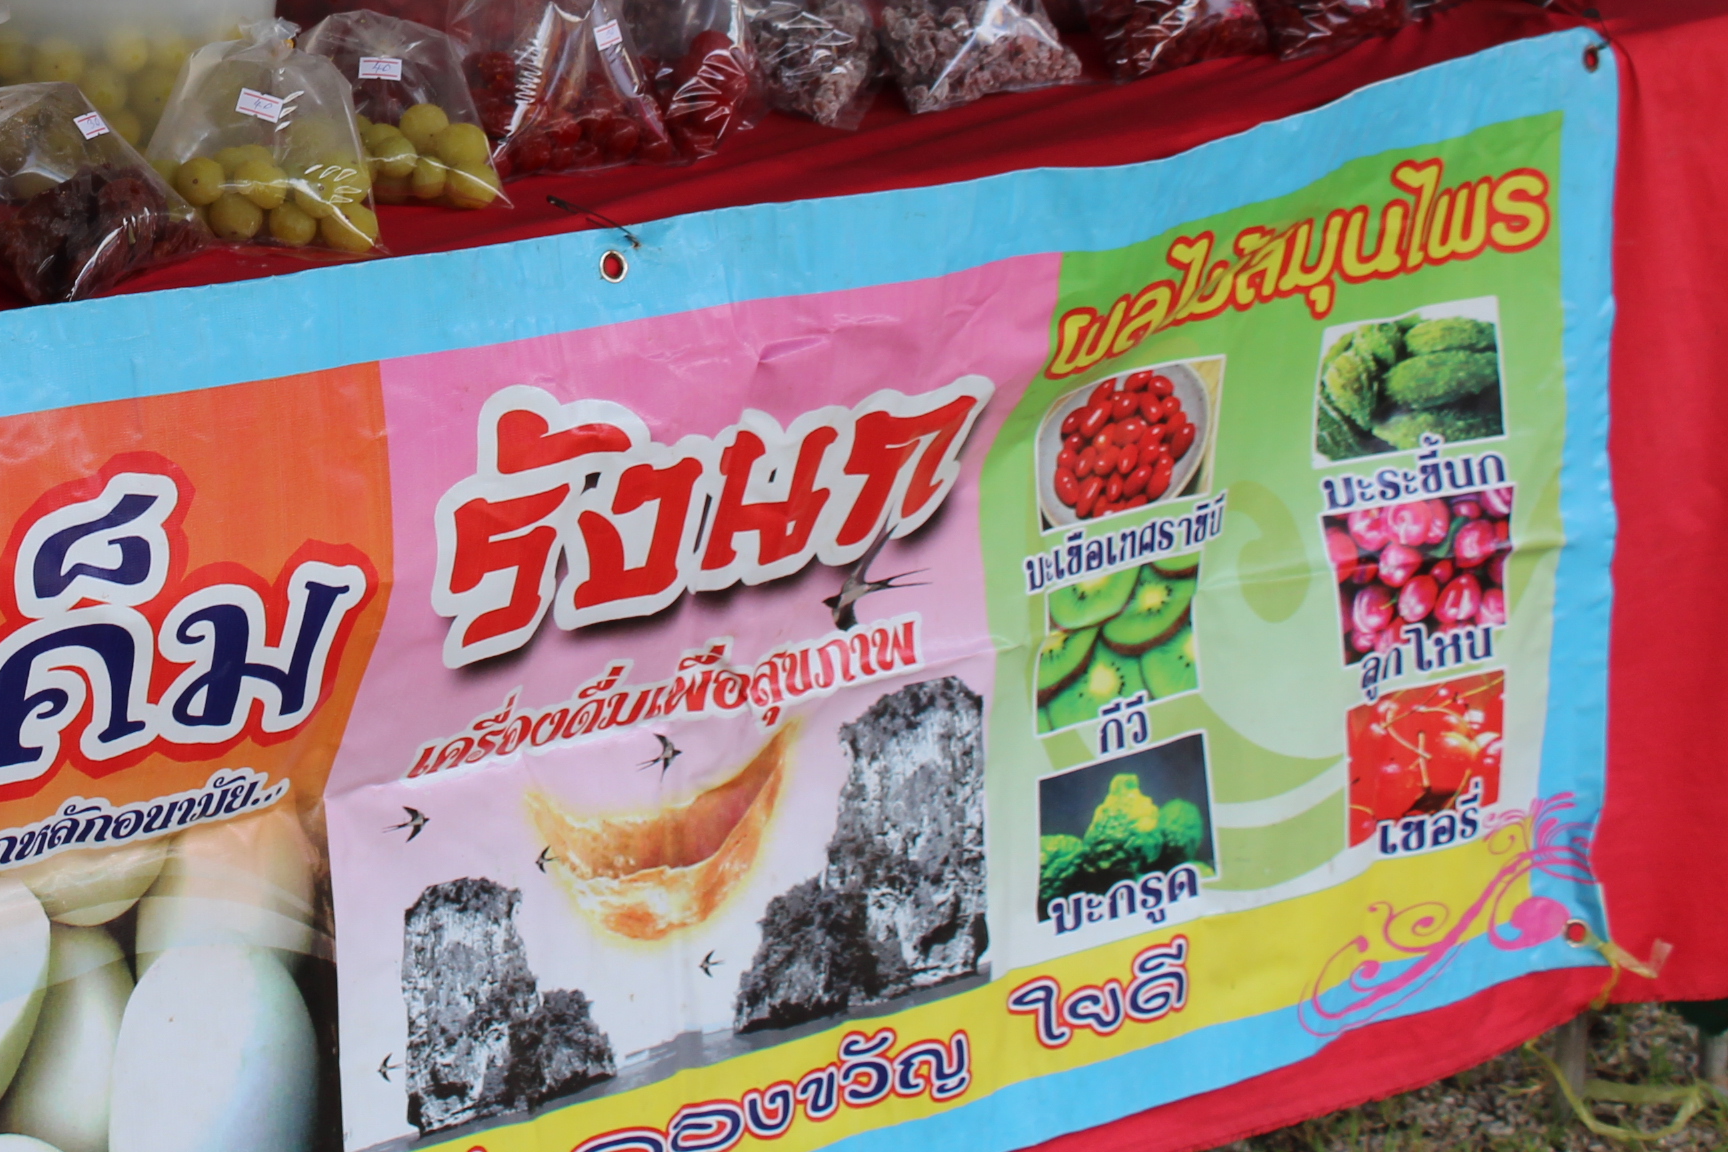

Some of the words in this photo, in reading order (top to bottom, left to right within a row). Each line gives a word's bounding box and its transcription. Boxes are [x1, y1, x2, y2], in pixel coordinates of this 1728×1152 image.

[1323, 434, 1506, 510] มะระขี้นก
[440, 385, 985, 658] รังนก
[1025, 492, 1228, 591] มะเขือเทศราชินี
[406, 619, 918, 780] เครื่องดื่มเพื่อสุขภาพ
[1099, 693, 1149, 754] กีวี
[1378, 780, 1480, 856] เชอรี่
[1050, 865, 1200, 935] มะกรูด
